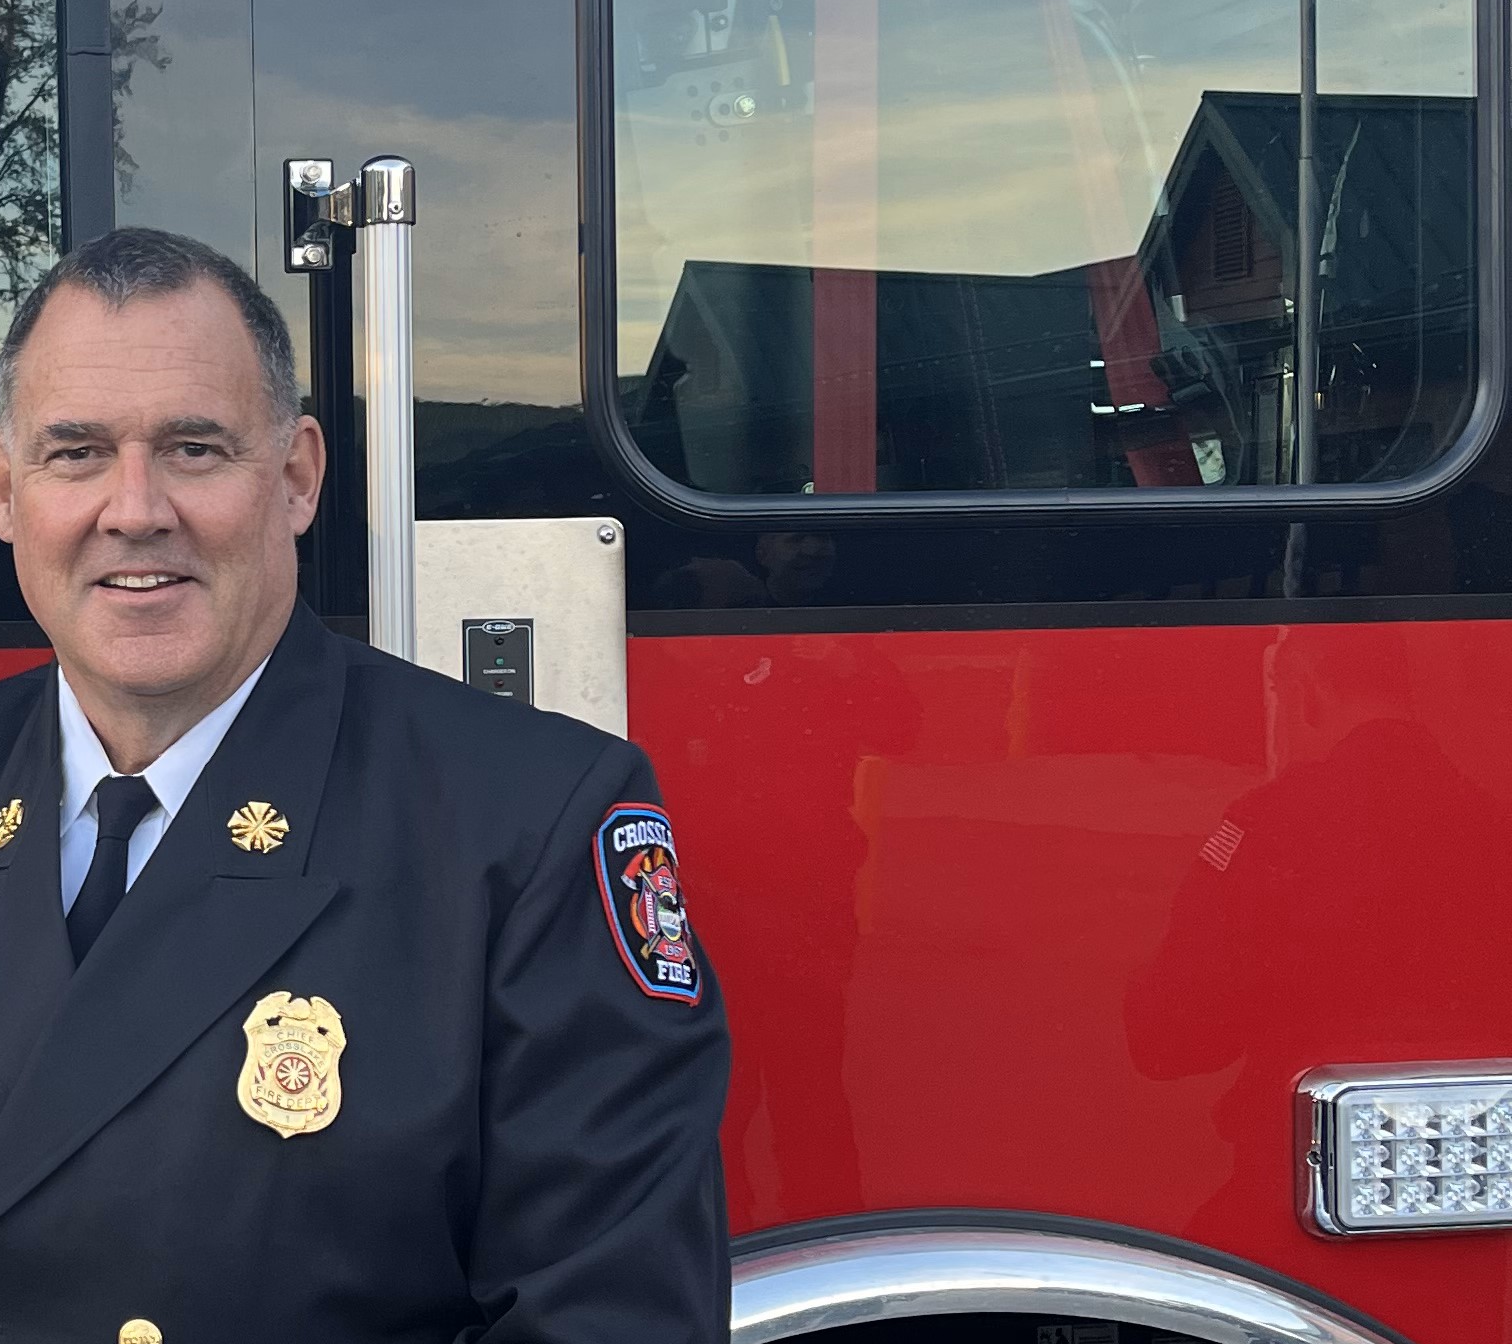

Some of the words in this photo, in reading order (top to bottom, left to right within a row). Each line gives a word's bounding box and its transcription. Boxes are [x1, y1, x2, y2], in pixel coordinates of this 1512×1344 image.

[656, 960, 692, 985] FIRE
[276, 1030, 314, 1043] CHIEF
[264, 1042, 325, 1066] CROSSLAKE
[256, 1086, 282, 1104] FIRE
